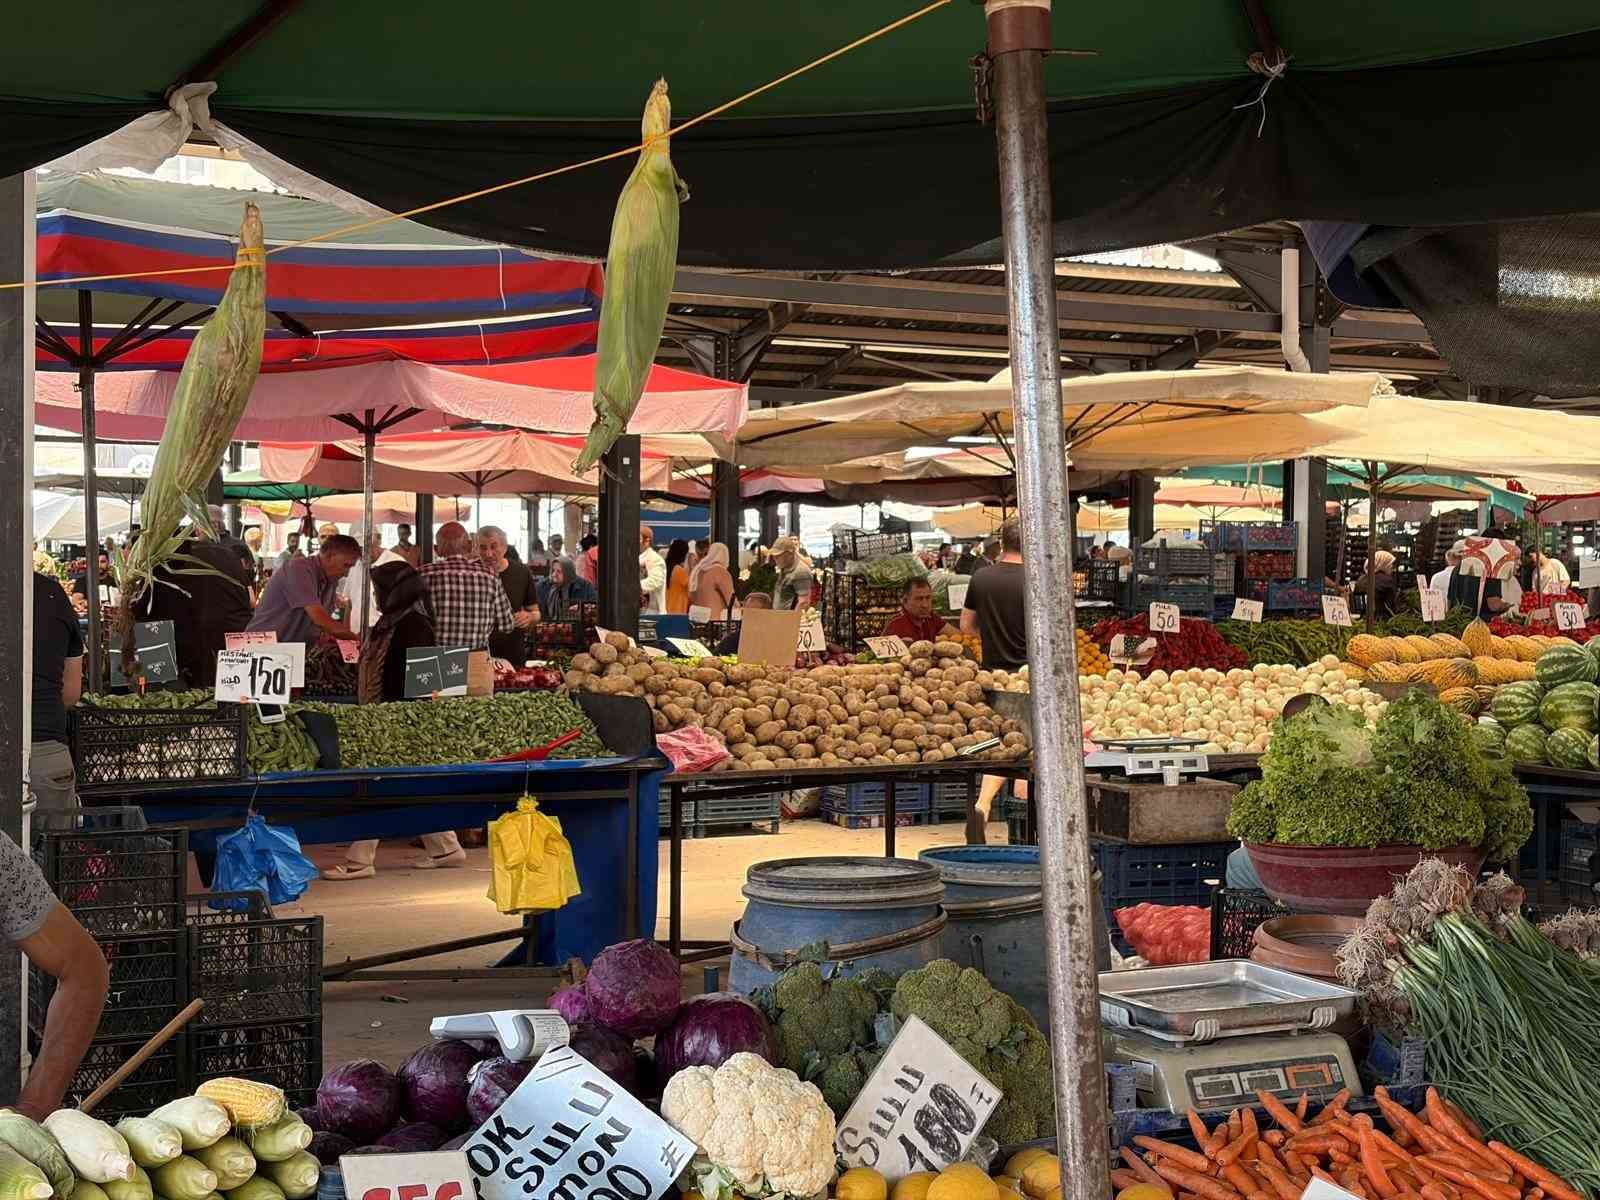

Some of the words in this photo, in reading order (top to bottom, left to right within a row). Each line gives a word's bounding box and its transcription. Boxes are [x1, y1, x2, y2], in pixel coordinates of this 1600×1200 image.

[1156, 611, 1175, 629] 50
[1562, 611, 1578, 627] 30
[248, 656, 286, 697] 150
[466, 1114, 535, 1200] OK
[505, 1081, 614, 1194] SULU
[838, 1065, 925, 1167] SULU
[897, 1083, 977, 1173] 100
